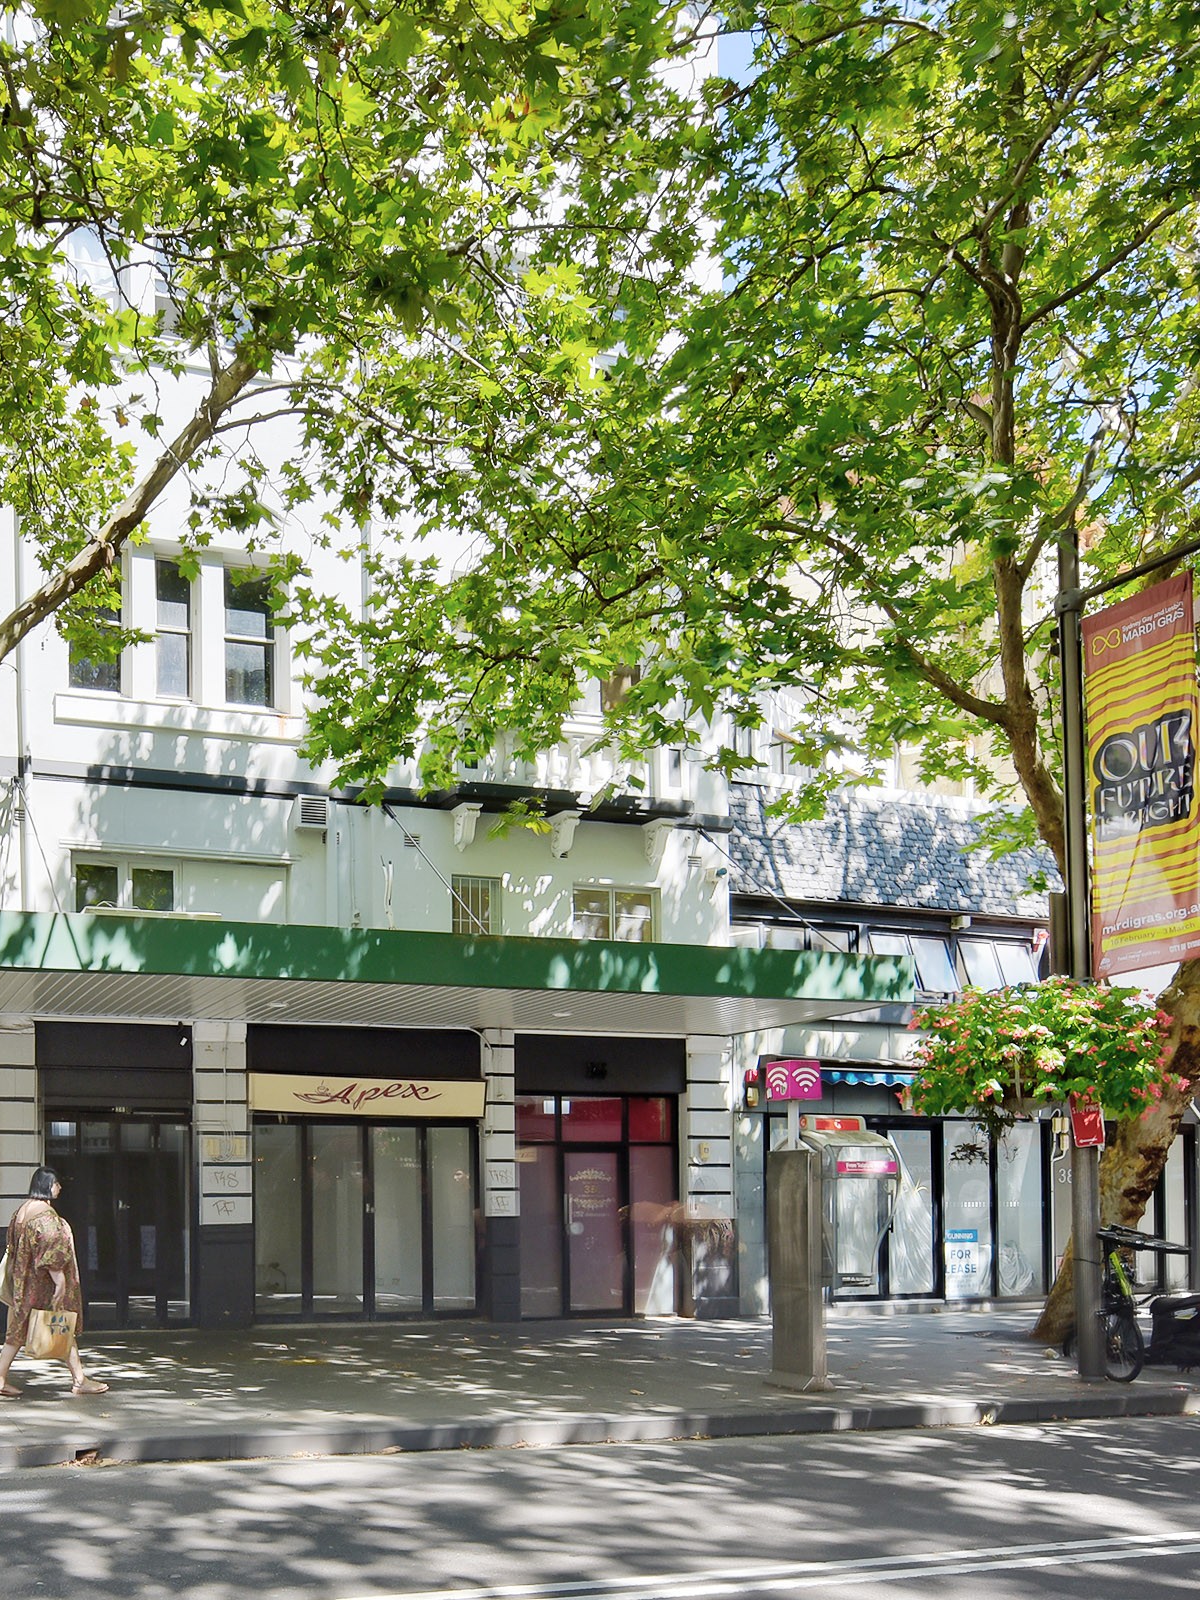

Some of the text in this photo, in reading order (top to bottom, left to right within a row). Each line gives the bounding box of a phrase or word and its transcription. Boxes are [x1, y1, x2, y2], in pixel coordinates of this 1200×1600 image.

[1122, 619, 1141, 632] Sydney
[1141, 615, 1153, 624] Gay
[1154, 610, 1165, 619] and
[1122, 608, 1184, 643] MARDI GRAS
[1100, 716, 1190, 781] OUR
[1101, 764, 1192, 813] FUTURE
[1119, 931, 1155, 944] February
[1168, 922, 1195, 934] March
[324, 1083, 443, 1111] Apex
[950, 1250, 971, 1259] FOR
[945, 1264, 977, 1273] LEASE
